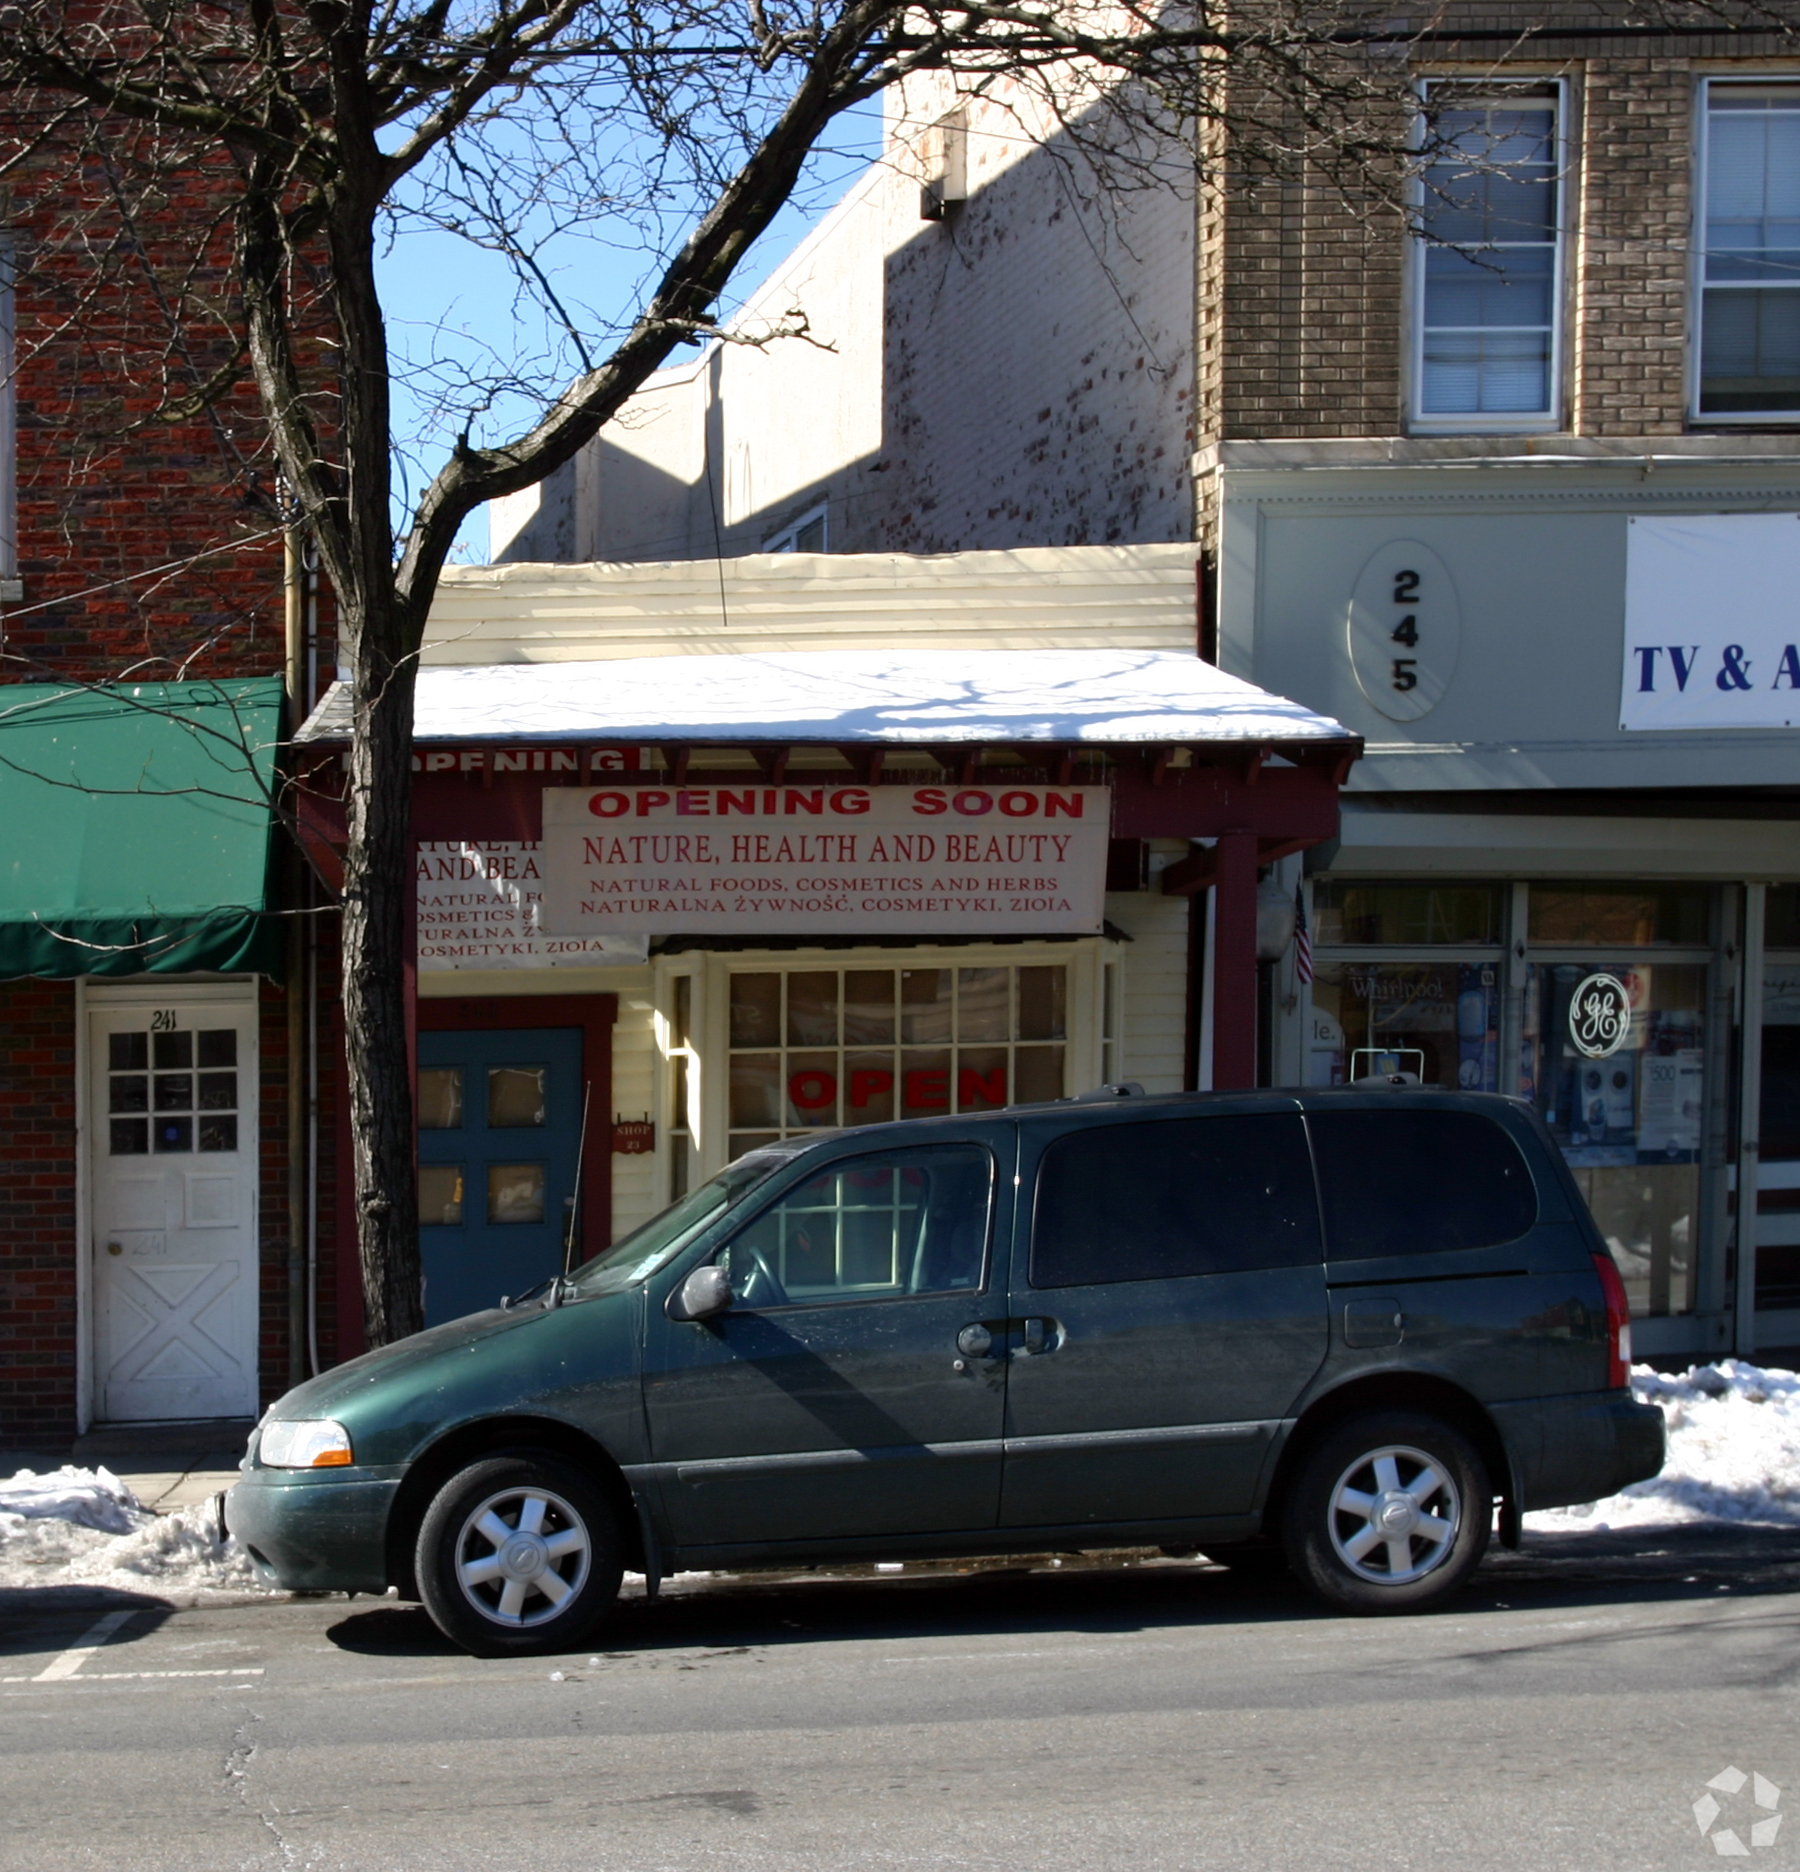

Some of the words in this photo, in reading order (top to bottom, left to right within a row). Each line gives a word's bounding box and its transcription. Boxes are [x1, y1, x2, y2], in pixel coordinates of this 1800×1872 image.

[1391, 569, 1420, 691] 245
[1633, 645, 1701, 692] TV
[1716, 644, 1753, 691] &
[587, 789, 871, 818] OPENING
[912, 789, 1084, 818] SOON
[583, 835, 720, 865] NATURE,
[732, 835, 857, 863] HEALTH
[868, 835, 936, 863] AND
[945, 834, 1072, 863] BEAUTY
[417, 858, 476, 881] AND
[485, 857, 541, 880] BEA
[590, 877, 702, 893] NATURAL
[796, 877, 923, 892] COSMETICS
[930, 877, 979, 892] AND
[986, 877, 1058, 891] HERBS
[580, 898, 726, 914] NATURALNA
[151, 1010, 177, 1031] 241
[789, 1068, 1007, 1109] OPEN
[616, 1125, 650, 1135] SHOP
